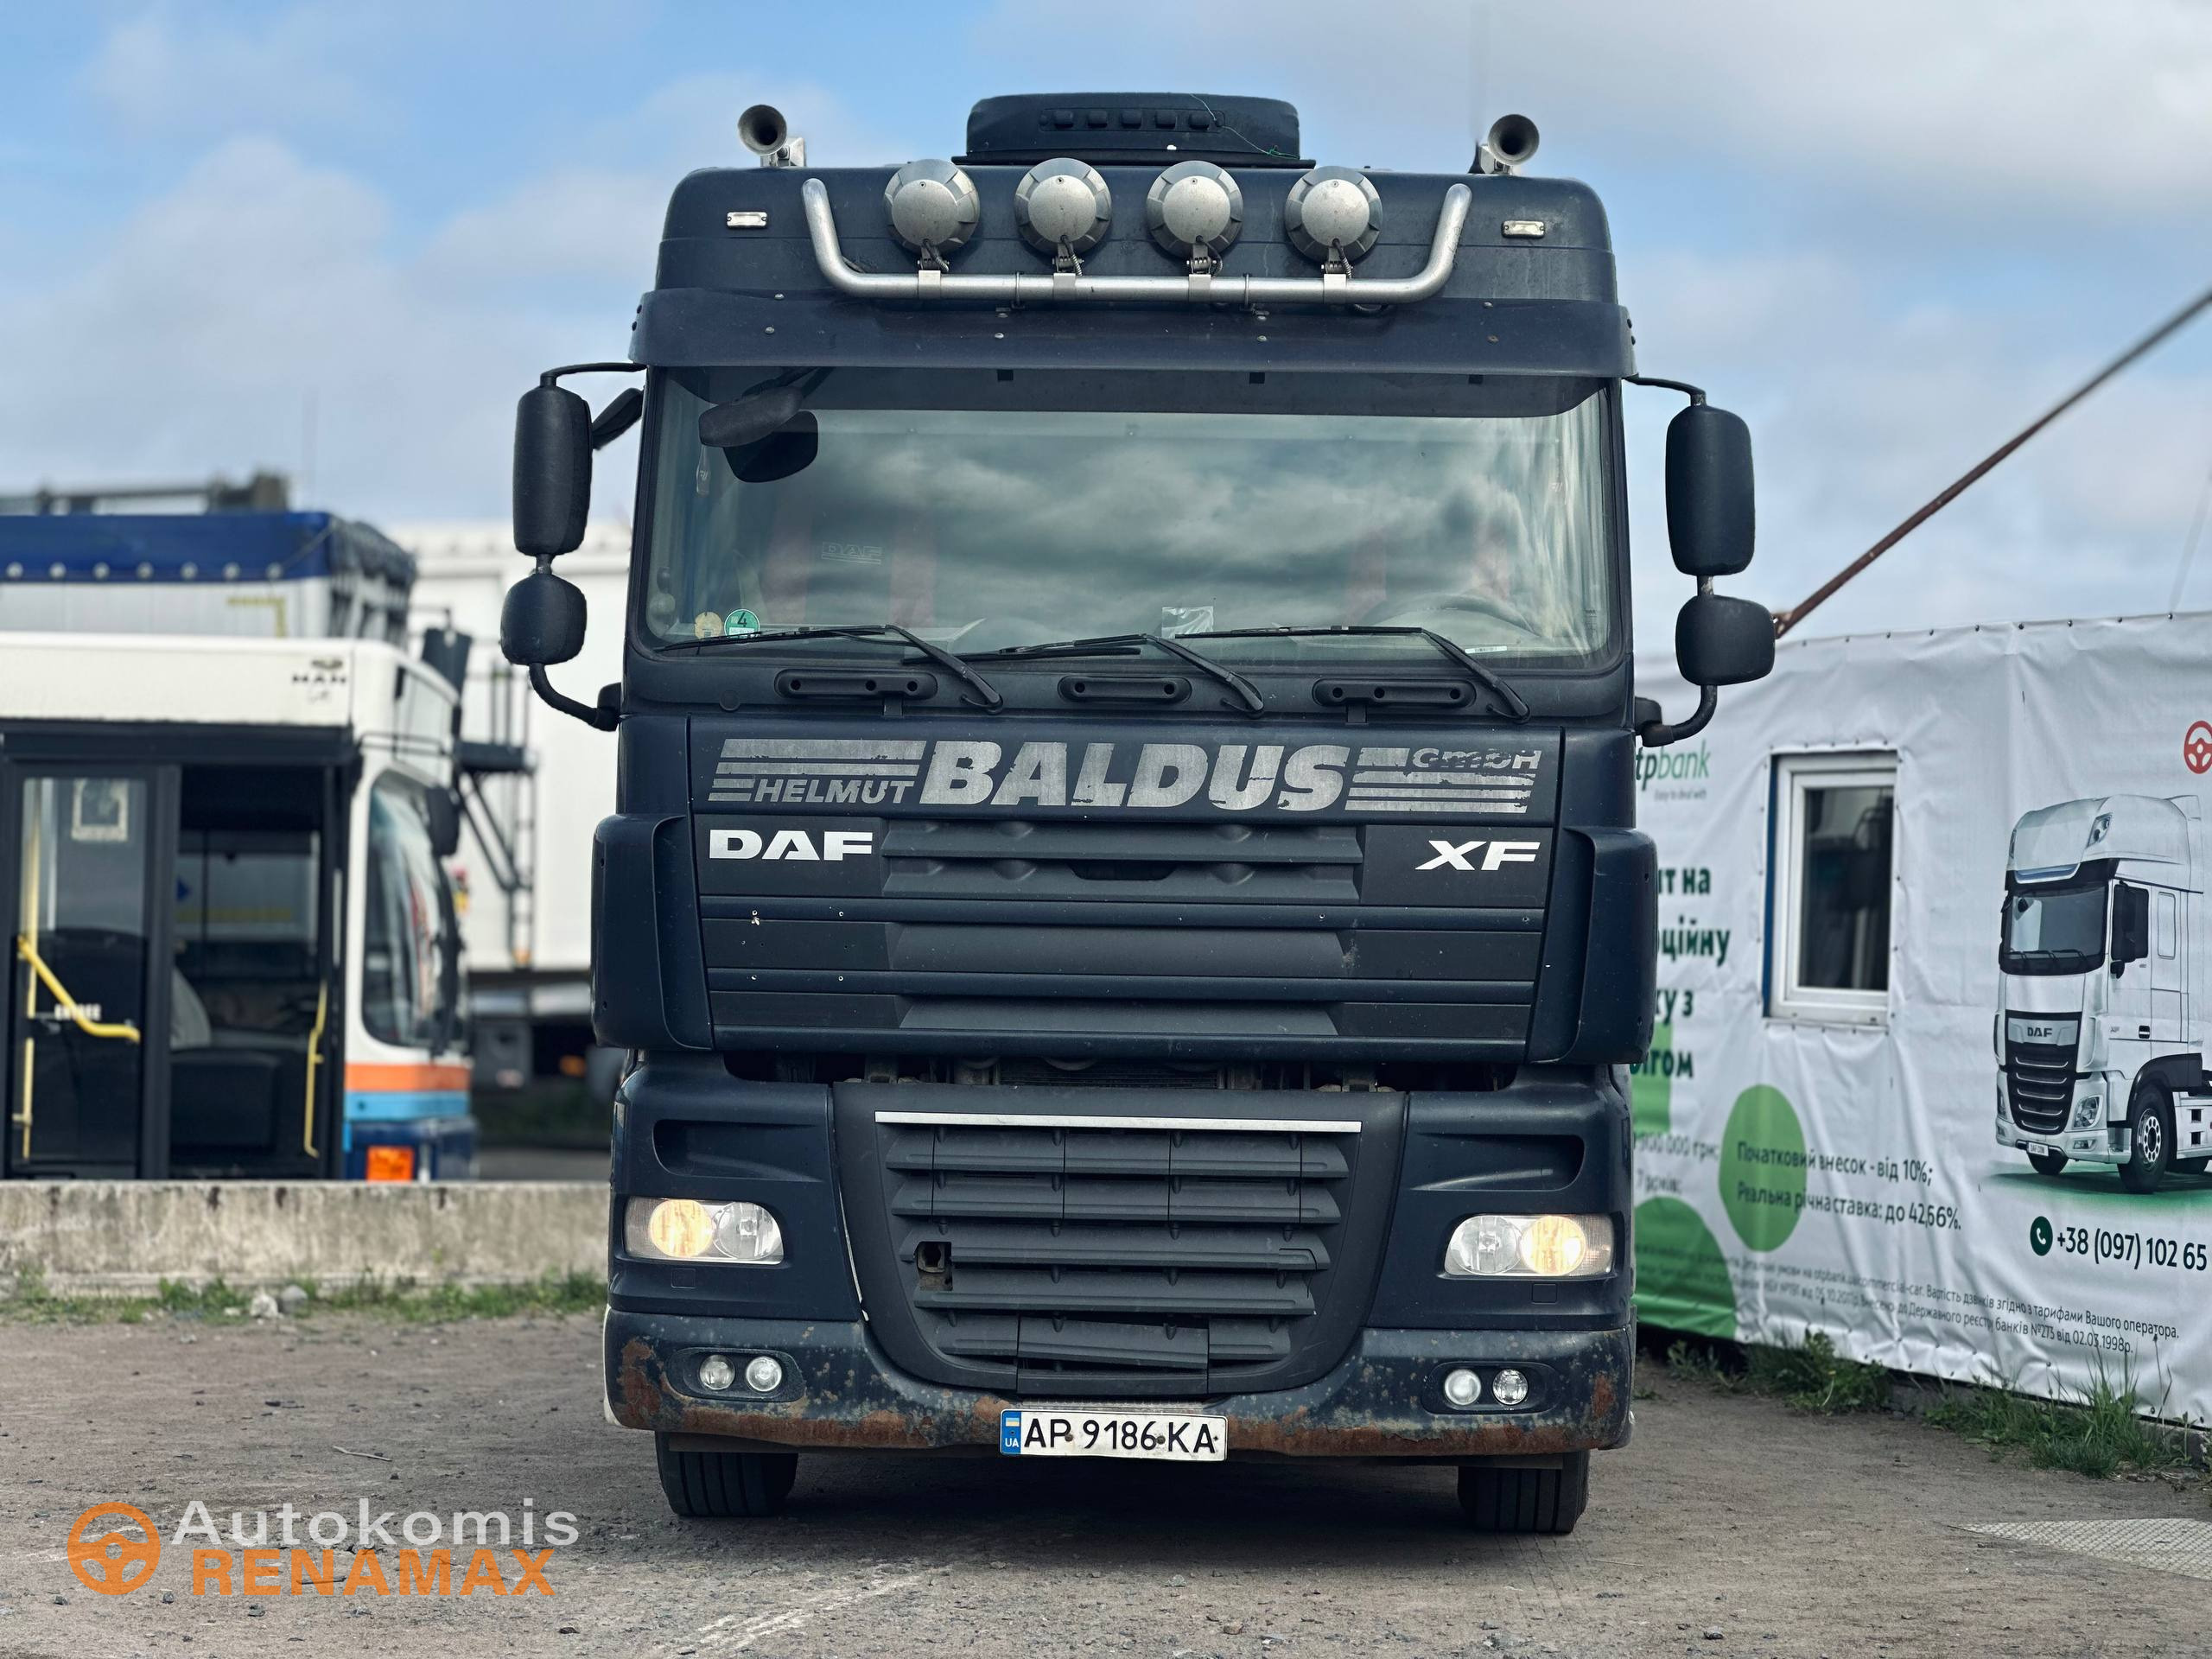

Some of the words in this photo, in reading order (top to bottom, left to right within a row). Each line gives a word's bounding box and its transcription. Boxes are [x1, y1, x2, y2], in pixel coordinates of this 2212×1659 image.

[737, 612, 747, 628] 4
[753, 779, 915, 804] HELMUT
[918, 741, 1351, 811] BALDUS
[1635, 739, 1711, 791] tpbank
[709, 830, 874, 861] DAF
[1414, 840, 1541, 871] XF
[1681, 868, 1711, 895] на
[1658, 916, 1731, 967] ційну
[2027, 1027, 2053, 1038] DAF
[1737, 1141, 1816, 1169] Початковий
[1819, 1154, 1866, 1176] внесок
[1877, 1158, 1899, 1182] від
[1903, 1159, 1934, 1187] 10%;
[1737, 1180, 1792, 1208] Реальна
[1885, 1203, 1906, 1227] до
[2056, 1226, 2089, 1255] +38
[2094, 1227, 2142, 1271] (097)
[2145, 1236, 2178, 1268] 102
[2183, 1242, 2208, 1272] 65
[1909, 1302, 1961, 1324] Державного
[1995, 1317, 2029, 1335] банків
[2057, 1331, 2072, 1345] від
[1997, 1298, 2026, 1314] згідно
[2033, 1306, 2083, 1324] тарифами
[2086, 1310, 2121, 1329] Вашого
[2123, 1319, 2180, 1339] оператора.
[1005, 1438, 1020, 1448] UA
[1024, 1418, 1071, 1449] AP
[1083, 1420, 1157, 1451] 9186
[1168, 1421, 1216, 1453] KA
